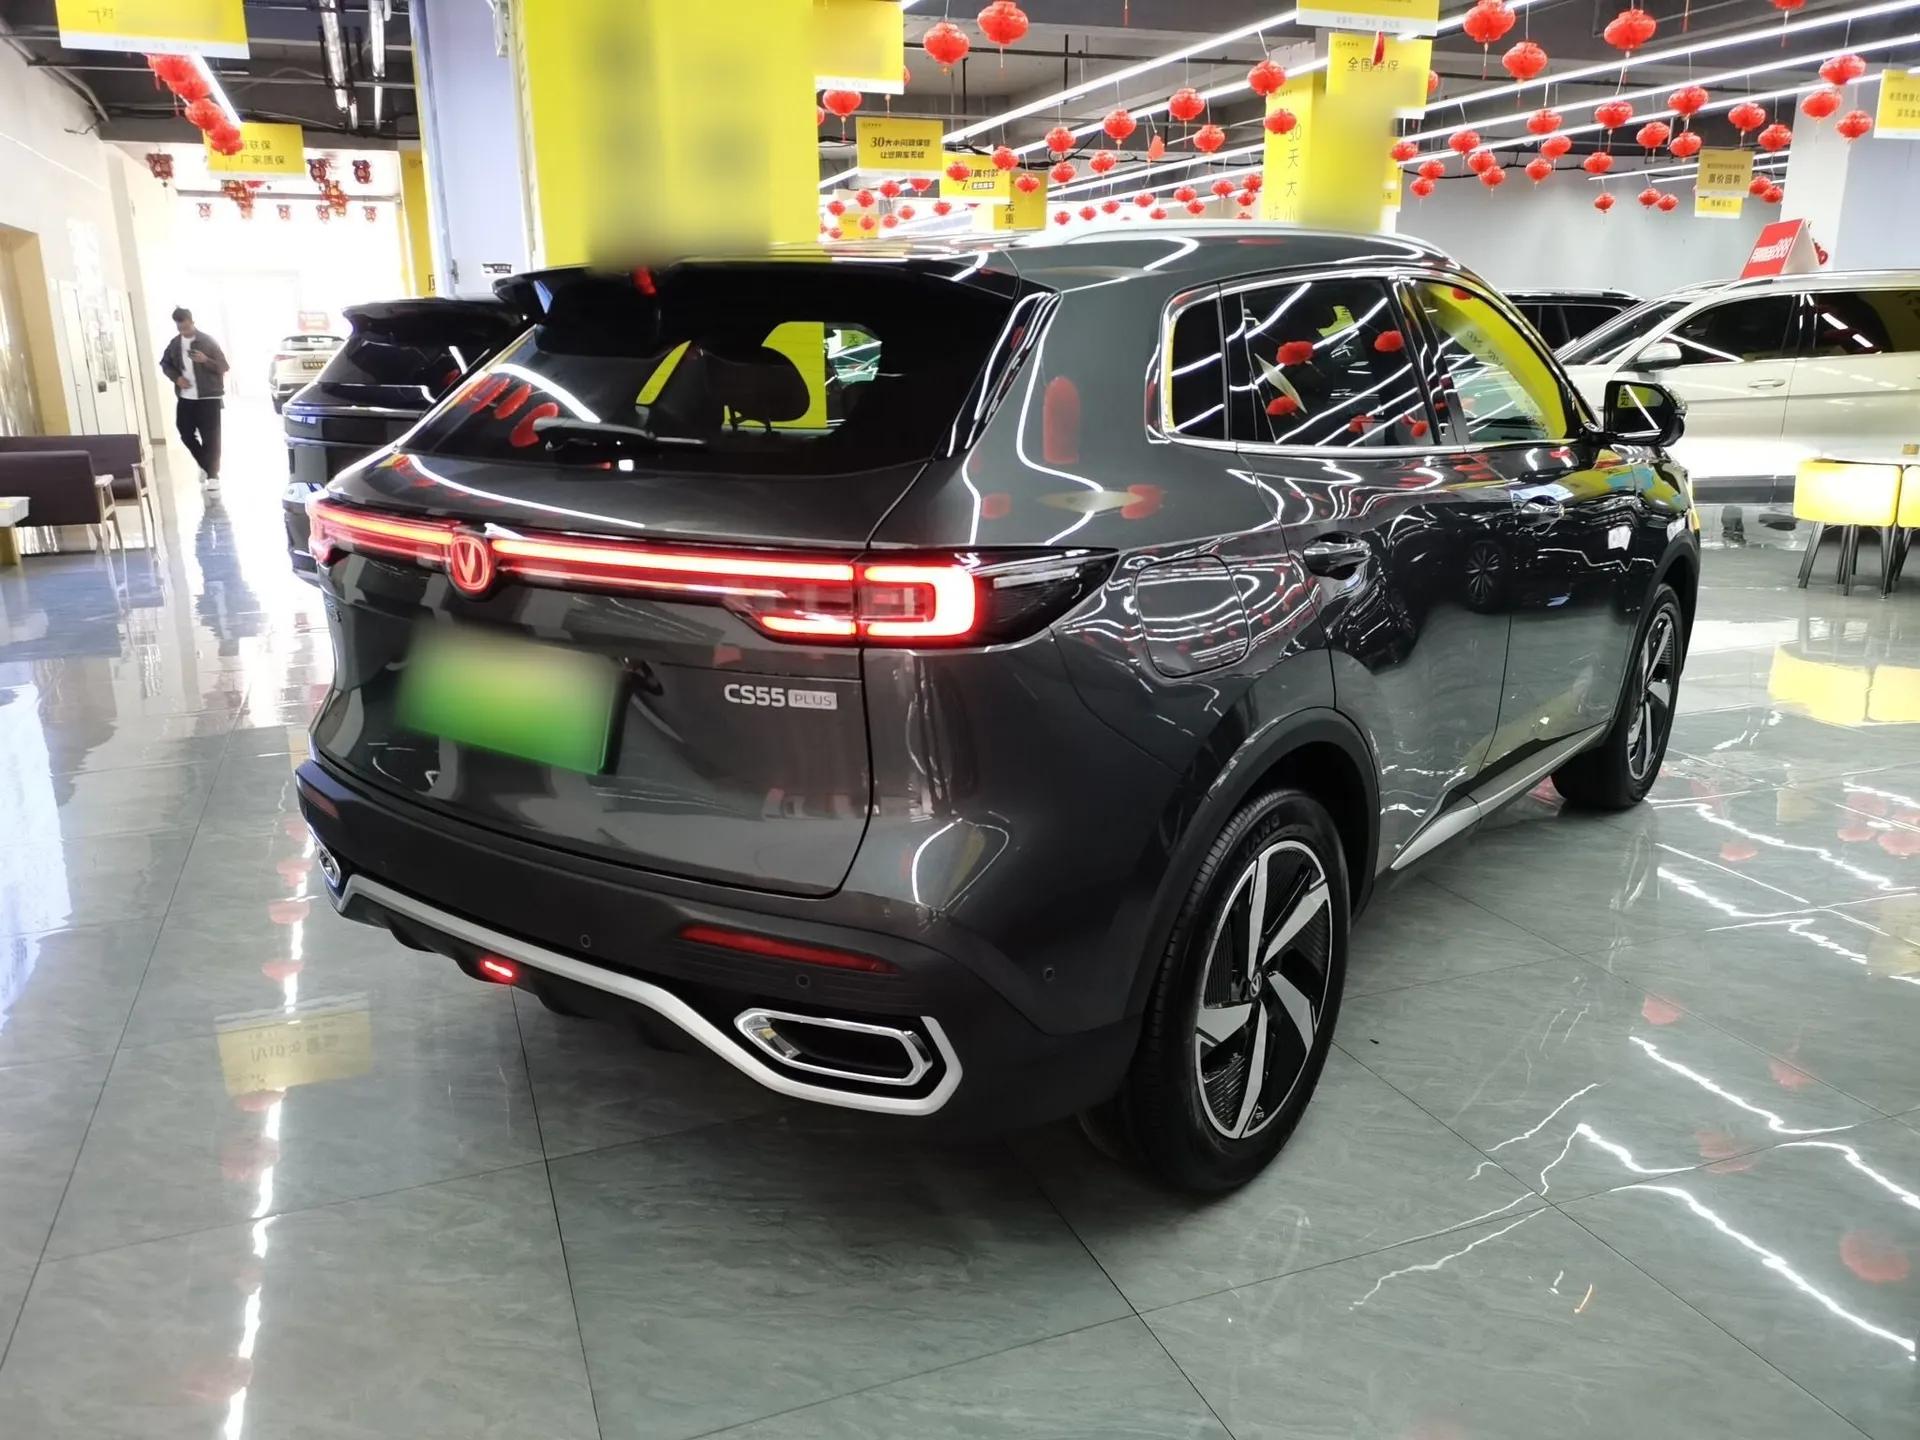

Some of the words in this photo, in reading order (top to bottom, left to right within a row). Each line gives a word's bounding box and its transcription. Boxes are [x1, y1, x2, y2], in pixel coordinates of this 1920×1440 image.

[1347, 57, 1400, 72] 全国保
[724, 683, 786, 708] CS55
[793, 692, 833, 707] PLUS
